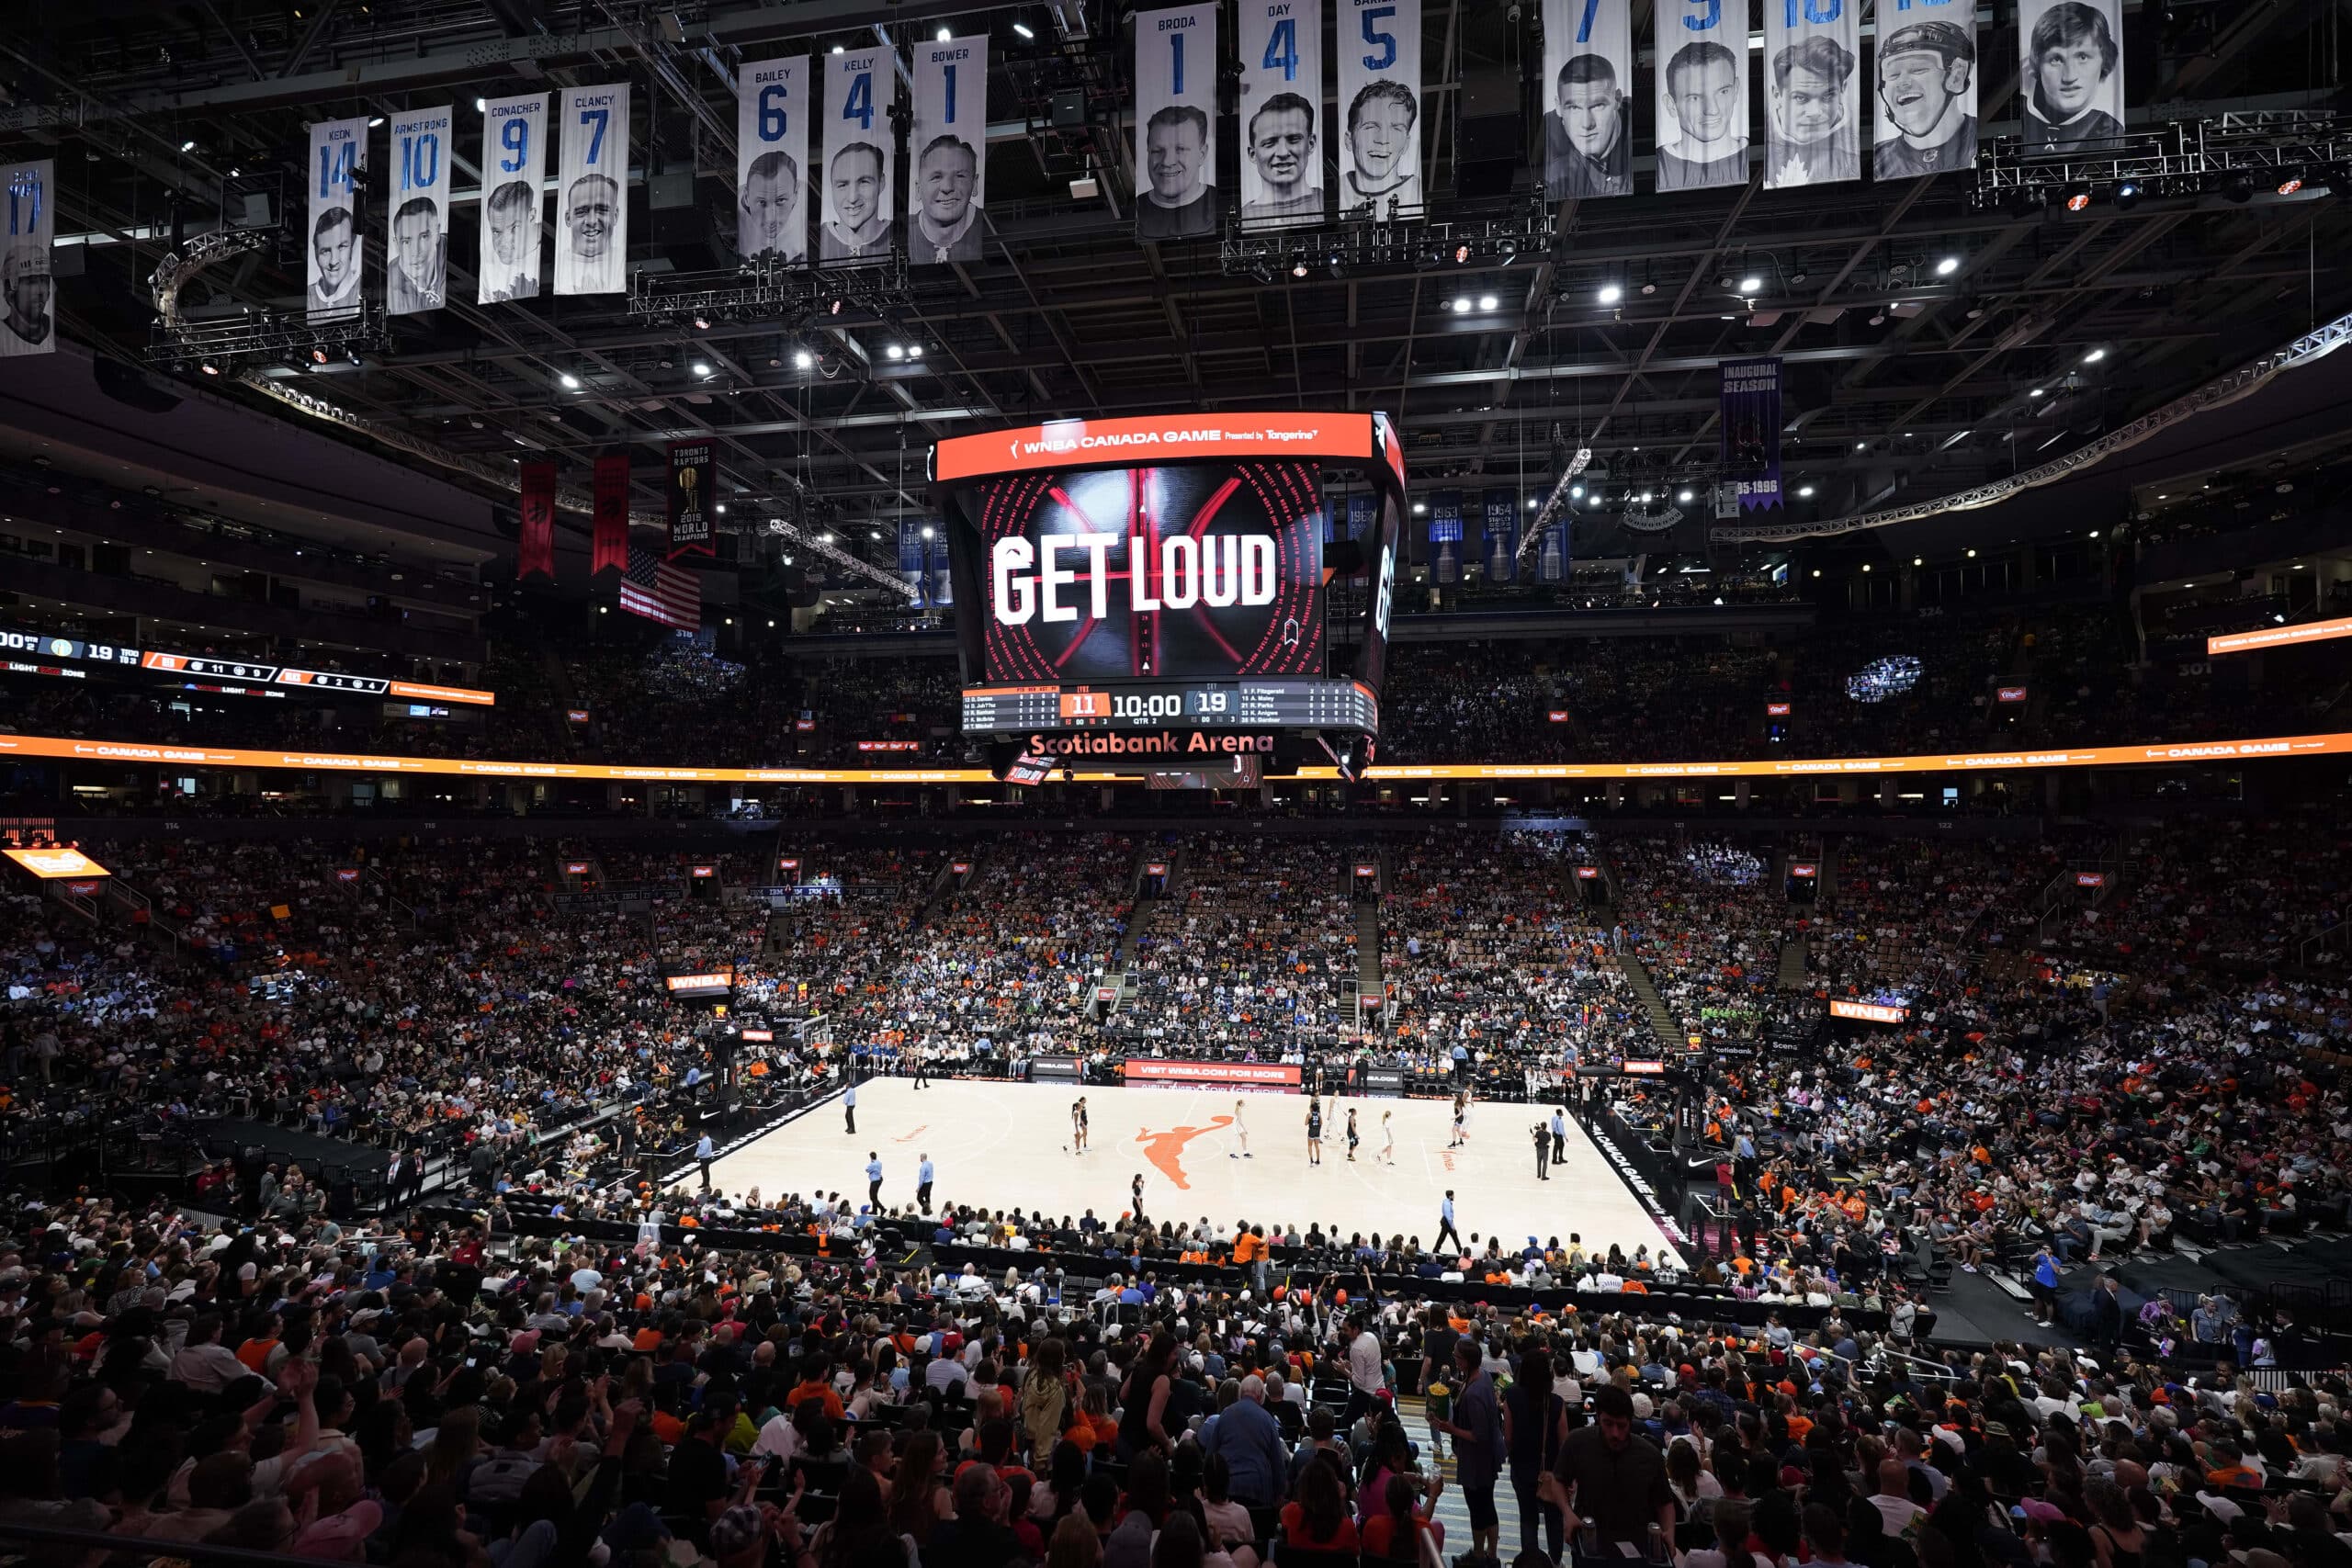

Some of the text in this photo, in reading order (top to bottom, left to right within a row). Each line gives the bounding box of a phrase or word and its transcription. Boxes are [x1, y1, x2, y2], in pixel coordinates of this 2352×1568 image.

[1268, 3, 1291, 17] DAY
[1159, 16, 1196, 31] BRODA
[1362, 6, 1396, 71] 5
[932, 48, 969, 62] BOWER
[1262, 18, 1299, 82] 4
[844, 57, 875, 73] KELLY
[1170, 33, 1184, 96] 1
[755, 68, 791, 84] BAILEY
[575, 95, 615, 108] CLANCY
[842, 72, 874, 130] 4
[944, 64, 956, 124] 1
[492, 102, 541, 118] CONACHER
[758, 84, 787, 142] 6
[394, 118, 447, 135] ARMSTRONG
[328, 129, 351, 142] KEON
[580, 108, 608, 164] 7
[500, 118, 529, 173] 9
[401, 133, 438, 190] 10
[320, 141, 356, 198] 14
[8, 181, 42, 235] 17
[1724, 363, 1778, 379] INAUGURAL
[1724, 378, 1776, 393] SEASON
[1024, 429, 1313, 453] WNBA CANADA GAME Presented by Tangerine
[674, 446, 709, 457] TORONTO
[673, 456, 709, 467] RAPTORS
[1487, 502, 1512, 516] 1964
[673, 522, 709, 535] WORLD
[673, 532, 709, 542] CHAMPIONS
[992, 532, 1276, 626] GET LOUD
[25, 636, 39, 644] QTR
[27, 643, 35, 651] 2
[88, 644, 113, 660] 19
[8, 661, 38, 672] LIGHT
[61, 669, 86, 679] ZONE
[211, 664, 261, 677] 11 9
[2177, 661, 2212, 676] 301
[335, 678, 343, 686] 2
[221, 686, 246, 694] LIGHT
[1072, 694, 1096, 715] 11
[1114, 694, 1182, 717] 10:00
[1198, 693, 1227, 713] 19
[1102, 717, 1108, 726] 3
[1133, 717, 1158, 726] QTR 2
[1030, 731, 1274, 755] Scotiabank Arena
[2167, 746, 2236, 758] CANADA
[2239, 742, 2290, 754] GAME
[96, 746, 161, 759] CANADA
[164, 750, 206, 761] GAME
[1965, 754, 2068, 765] CANADA GAME
[303, 757, 401, 769] CANADA GAME
[475, 764, 557, 775] CANADA GAME
[1640, 766, 1685, 774] CANADA
[1792, 761, 1881, 772] CANADA GAME
[672, 975, 728, 990] WNBA
[745, 1031, 769, 1039] WNBA
[1141, 1066, 1285, 1079] VISIT WNBA.COM FOR MORE
[1627, 1063, 1660, 1071] WNBA
[765, 1108, 808, 1127] GAME
[1597, 1135, 1632, 1167] CANADA
[1622, 1168, 1655, 1195] GAME
